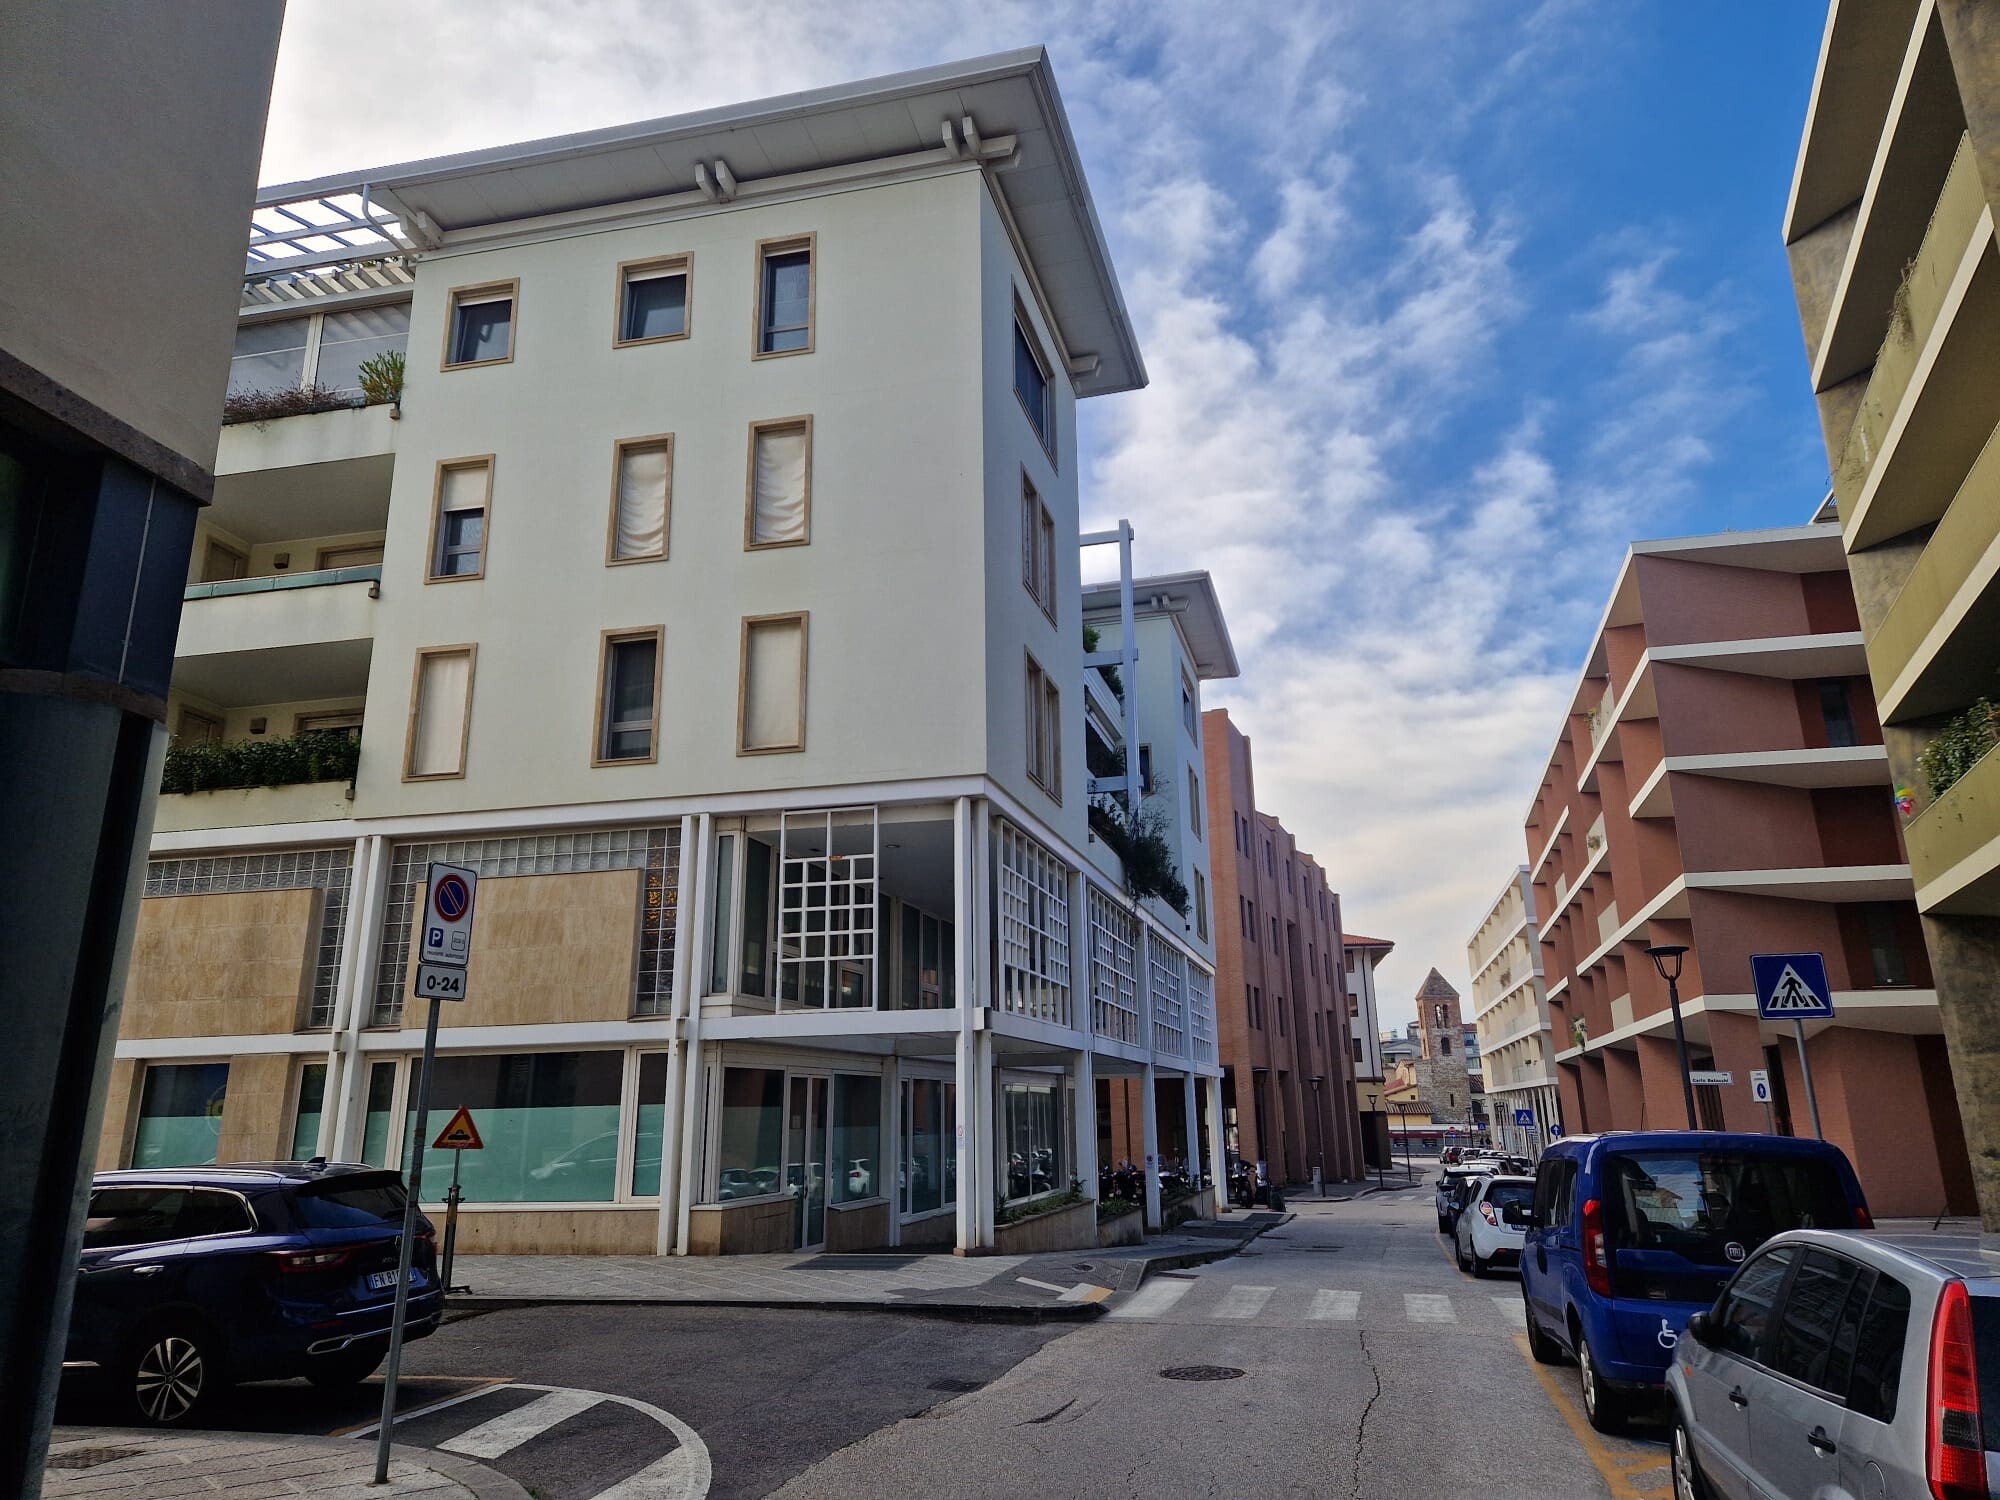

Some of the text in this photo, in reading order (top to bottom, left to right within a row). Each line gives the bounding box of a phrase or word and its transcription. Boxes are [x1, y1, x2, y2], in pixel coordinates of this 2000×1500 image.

[432, 930, 441, 945] P
[426, 975, 459, 993] 0-24
[1728, 1247, 1742, 1257] FIAT
